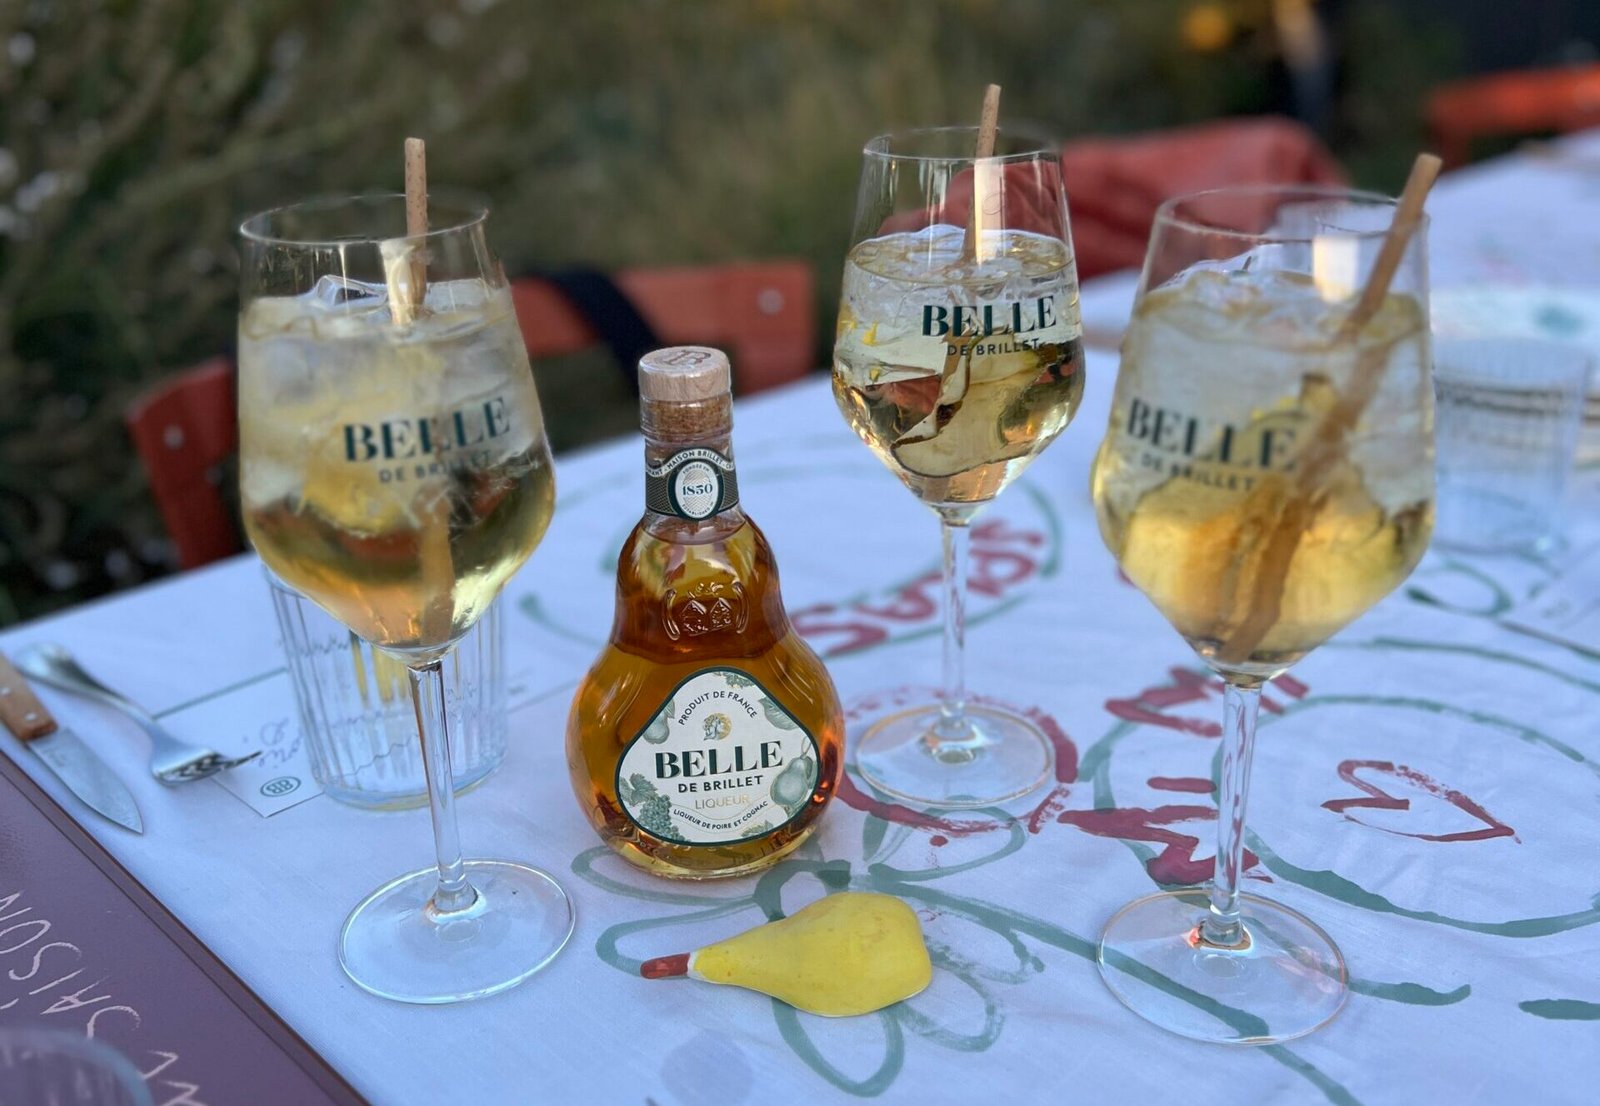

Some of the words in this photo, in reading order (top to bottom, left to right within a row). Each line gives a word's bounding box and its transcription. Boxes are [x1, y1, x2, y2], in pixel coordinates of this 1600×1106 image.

[922, 295, 1057, 337] BELLE
[947, 343, 971, 356] DE
[976, 337, 1040, 356] BRILLET
[344, 396, 511, 462] BELLE
[1128, 397, 1297, 467] BELLE
[378, 466, 404, 483] DE
[414, 449, 490, 480] BRIET
[667, 450, 695, 470] MAISON
[697, 450, 723, 466] BRILLET
[682, 483, 713, 496] 1850
[678, 692, 710, 726] PRODUIT
[713, 691, 725, 699] DE
[727, 691, 758, 719] FRANCE
[655, 740, 783, 779] BELLE
[678, 783, 697, 793] DE
[703, 775, 764, 792] BRILLET
[673, 808, 701, 826] LIQUEUR
[701, 821, 711, 830] DE
[733, 819, 742, 828] ET
[742, 801, 769, 822] COGNAC
[695, 794, 749, 811] LIQUEUR
